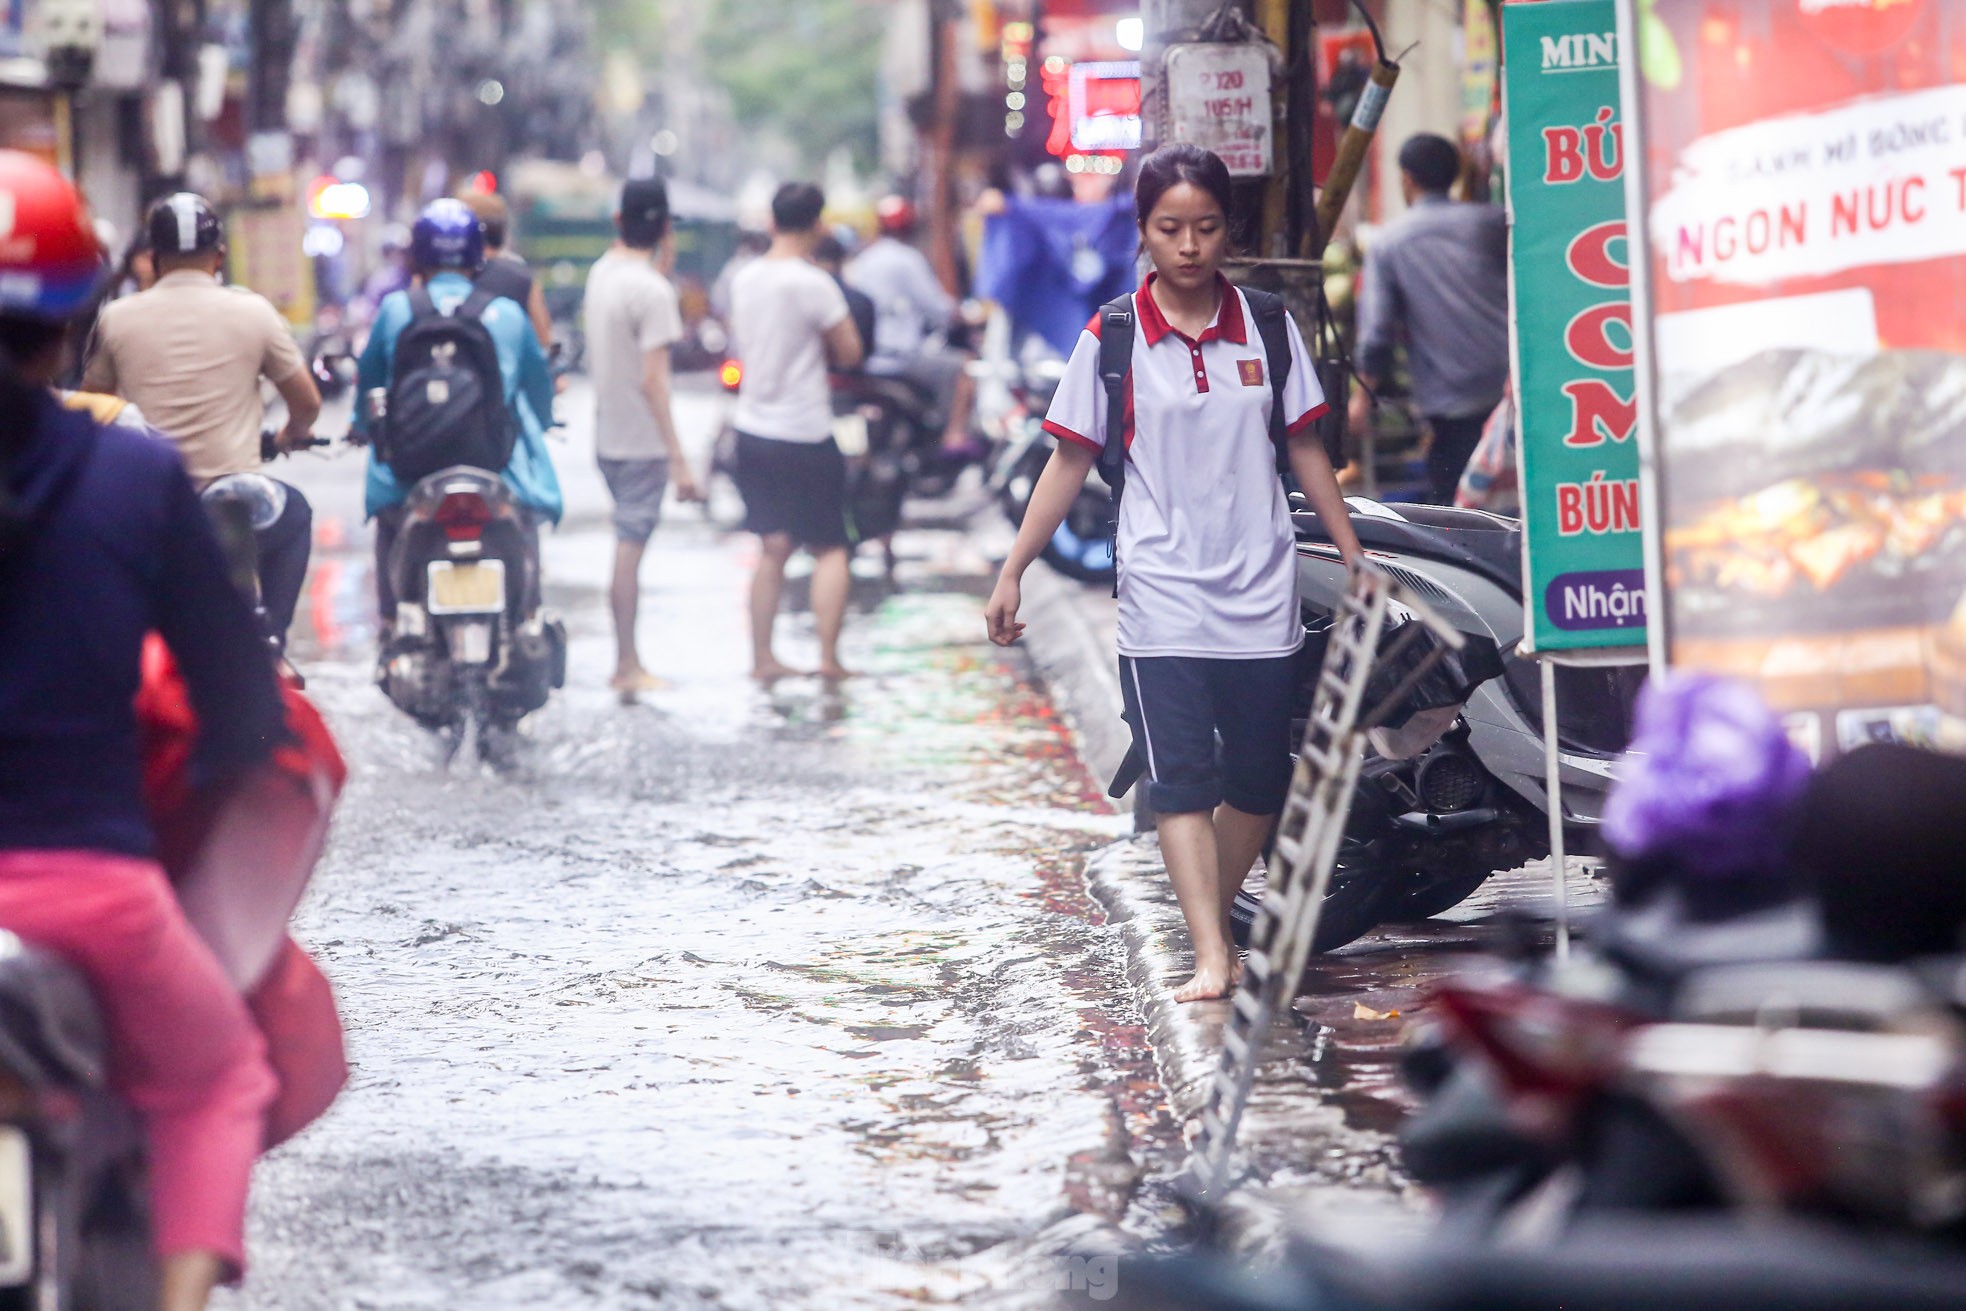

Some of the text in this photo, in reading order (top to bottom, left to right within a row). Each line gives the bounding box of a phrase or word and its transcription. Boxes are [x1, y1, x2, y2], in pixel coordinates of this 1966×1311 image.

[1540, 32, 1617, 68] MIN
[1676, 200, 1807, 269] NGON
[1556, 470, 1642, 537] BÚN
[1564, 582, 1648, 625] Nhận
